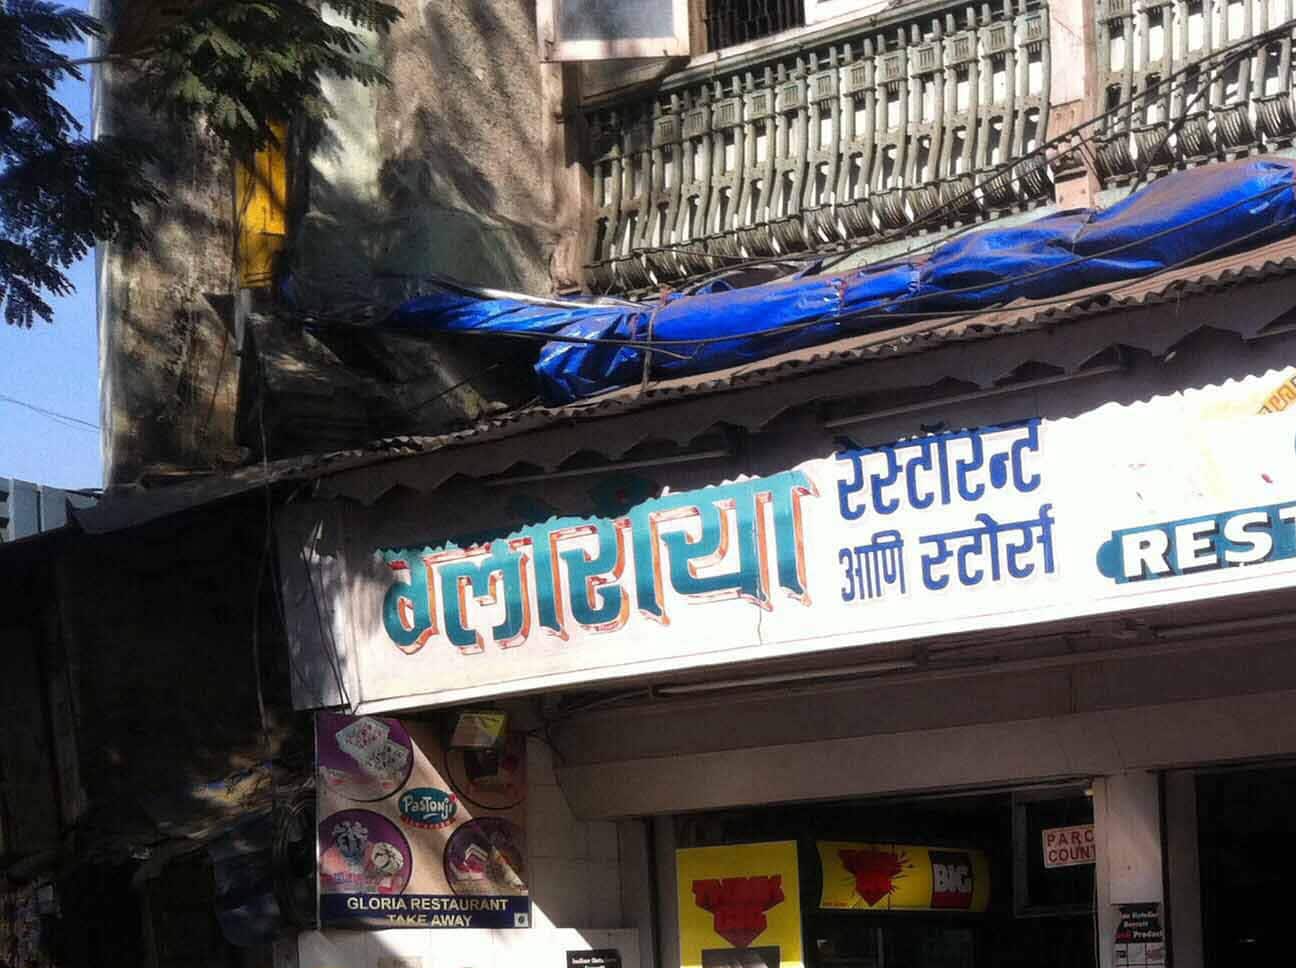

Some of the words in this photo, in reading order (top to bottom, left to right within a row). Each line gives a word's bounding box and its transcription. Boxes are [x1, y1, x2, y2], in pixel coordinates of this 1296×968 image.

[838, 529, 906, 602] आणि
[918, 503, 1056, 591] स्टोर्स
[934, 863, 971, 893] BIG
[346, 897, 407, 911] GLORIA
[410, 897, 509, 911] RESTAURANT
[387, 913, 428, 927] TAKE
[431, 913, 472, 927] AWAY
